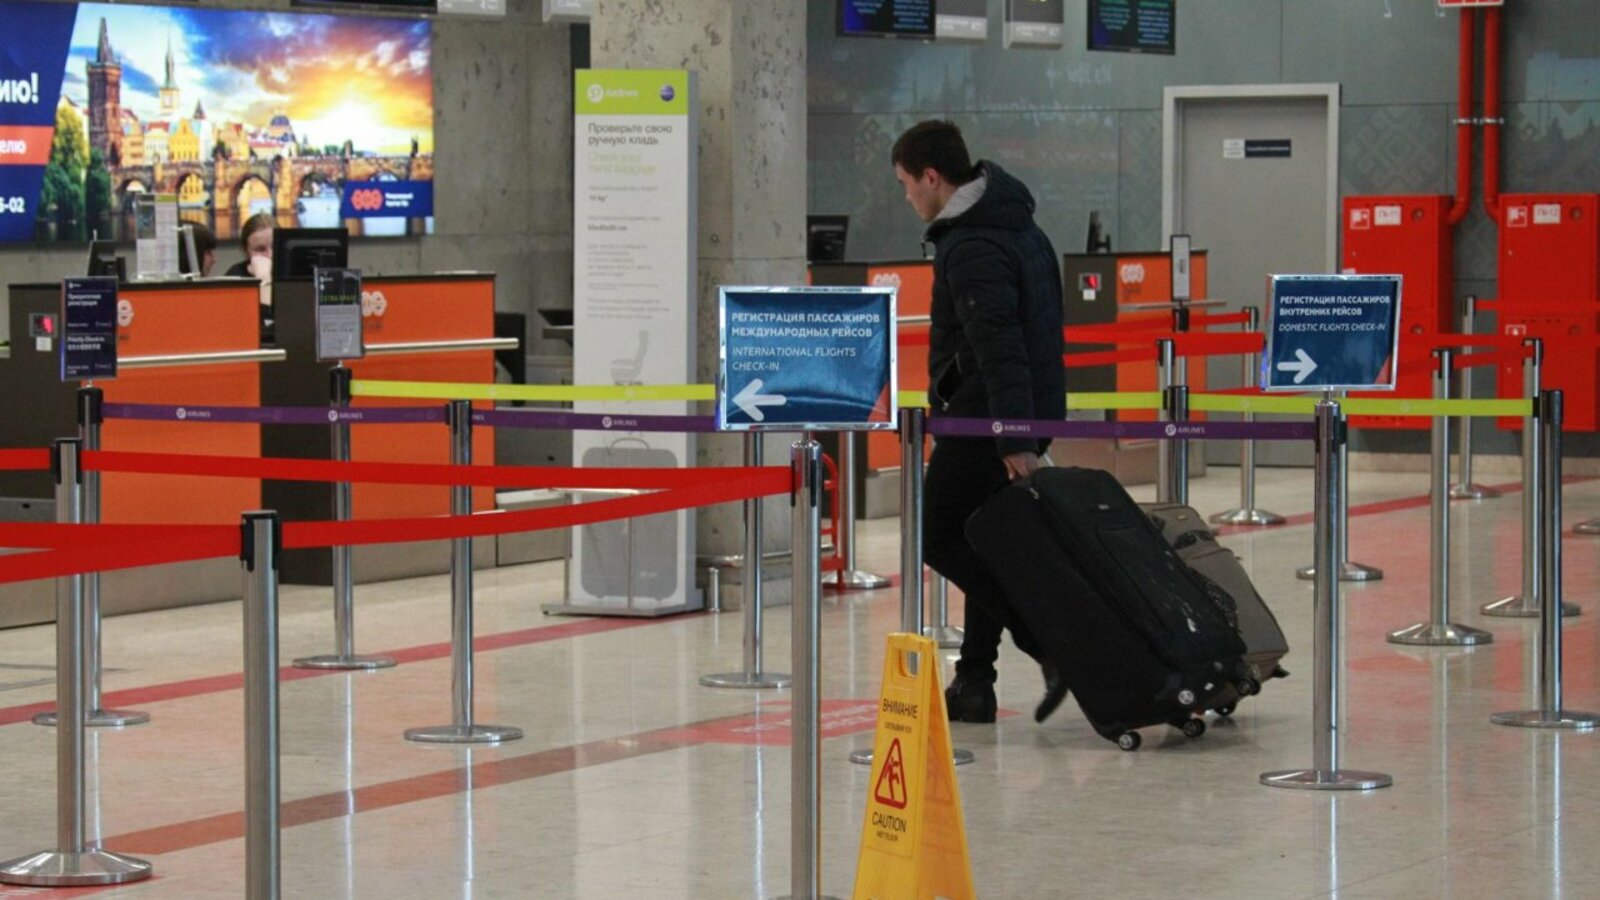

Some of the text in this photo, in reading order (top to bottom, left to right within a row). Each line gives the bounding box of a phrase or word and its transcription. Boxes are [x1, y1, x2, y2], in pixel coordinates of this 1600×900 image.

[588, 123, 673, 135] Проверьте свою
[588, 136, 659, 146] ручную кладь
[1280, 296, 1391, 304] РЕГИСТРАЦИЯ ПАССАЖИРОВ
[1279, 306, 1362, 316] ВНУТРЕННИХ РЕЙСОВ
[732, 313, 880, 323] РЕГИСТРАЦИЯ ПАССАЖИРОВ
[732, 326, 872, 338] МЕЖДУНАРОДНЫХ РЕЙСОВ
[1279, 323, 1386, 332] DOMESTIC FLIGHTS CHECK-IN
[732, 347, 856, 357] INTERNATIONAL FLIGHTS
[732, 361, 780, 371] CHECK-IN
[882, 698, 919, 719] ВНИМАНИЕ
[872, 811, 907, 833] CAUTION
